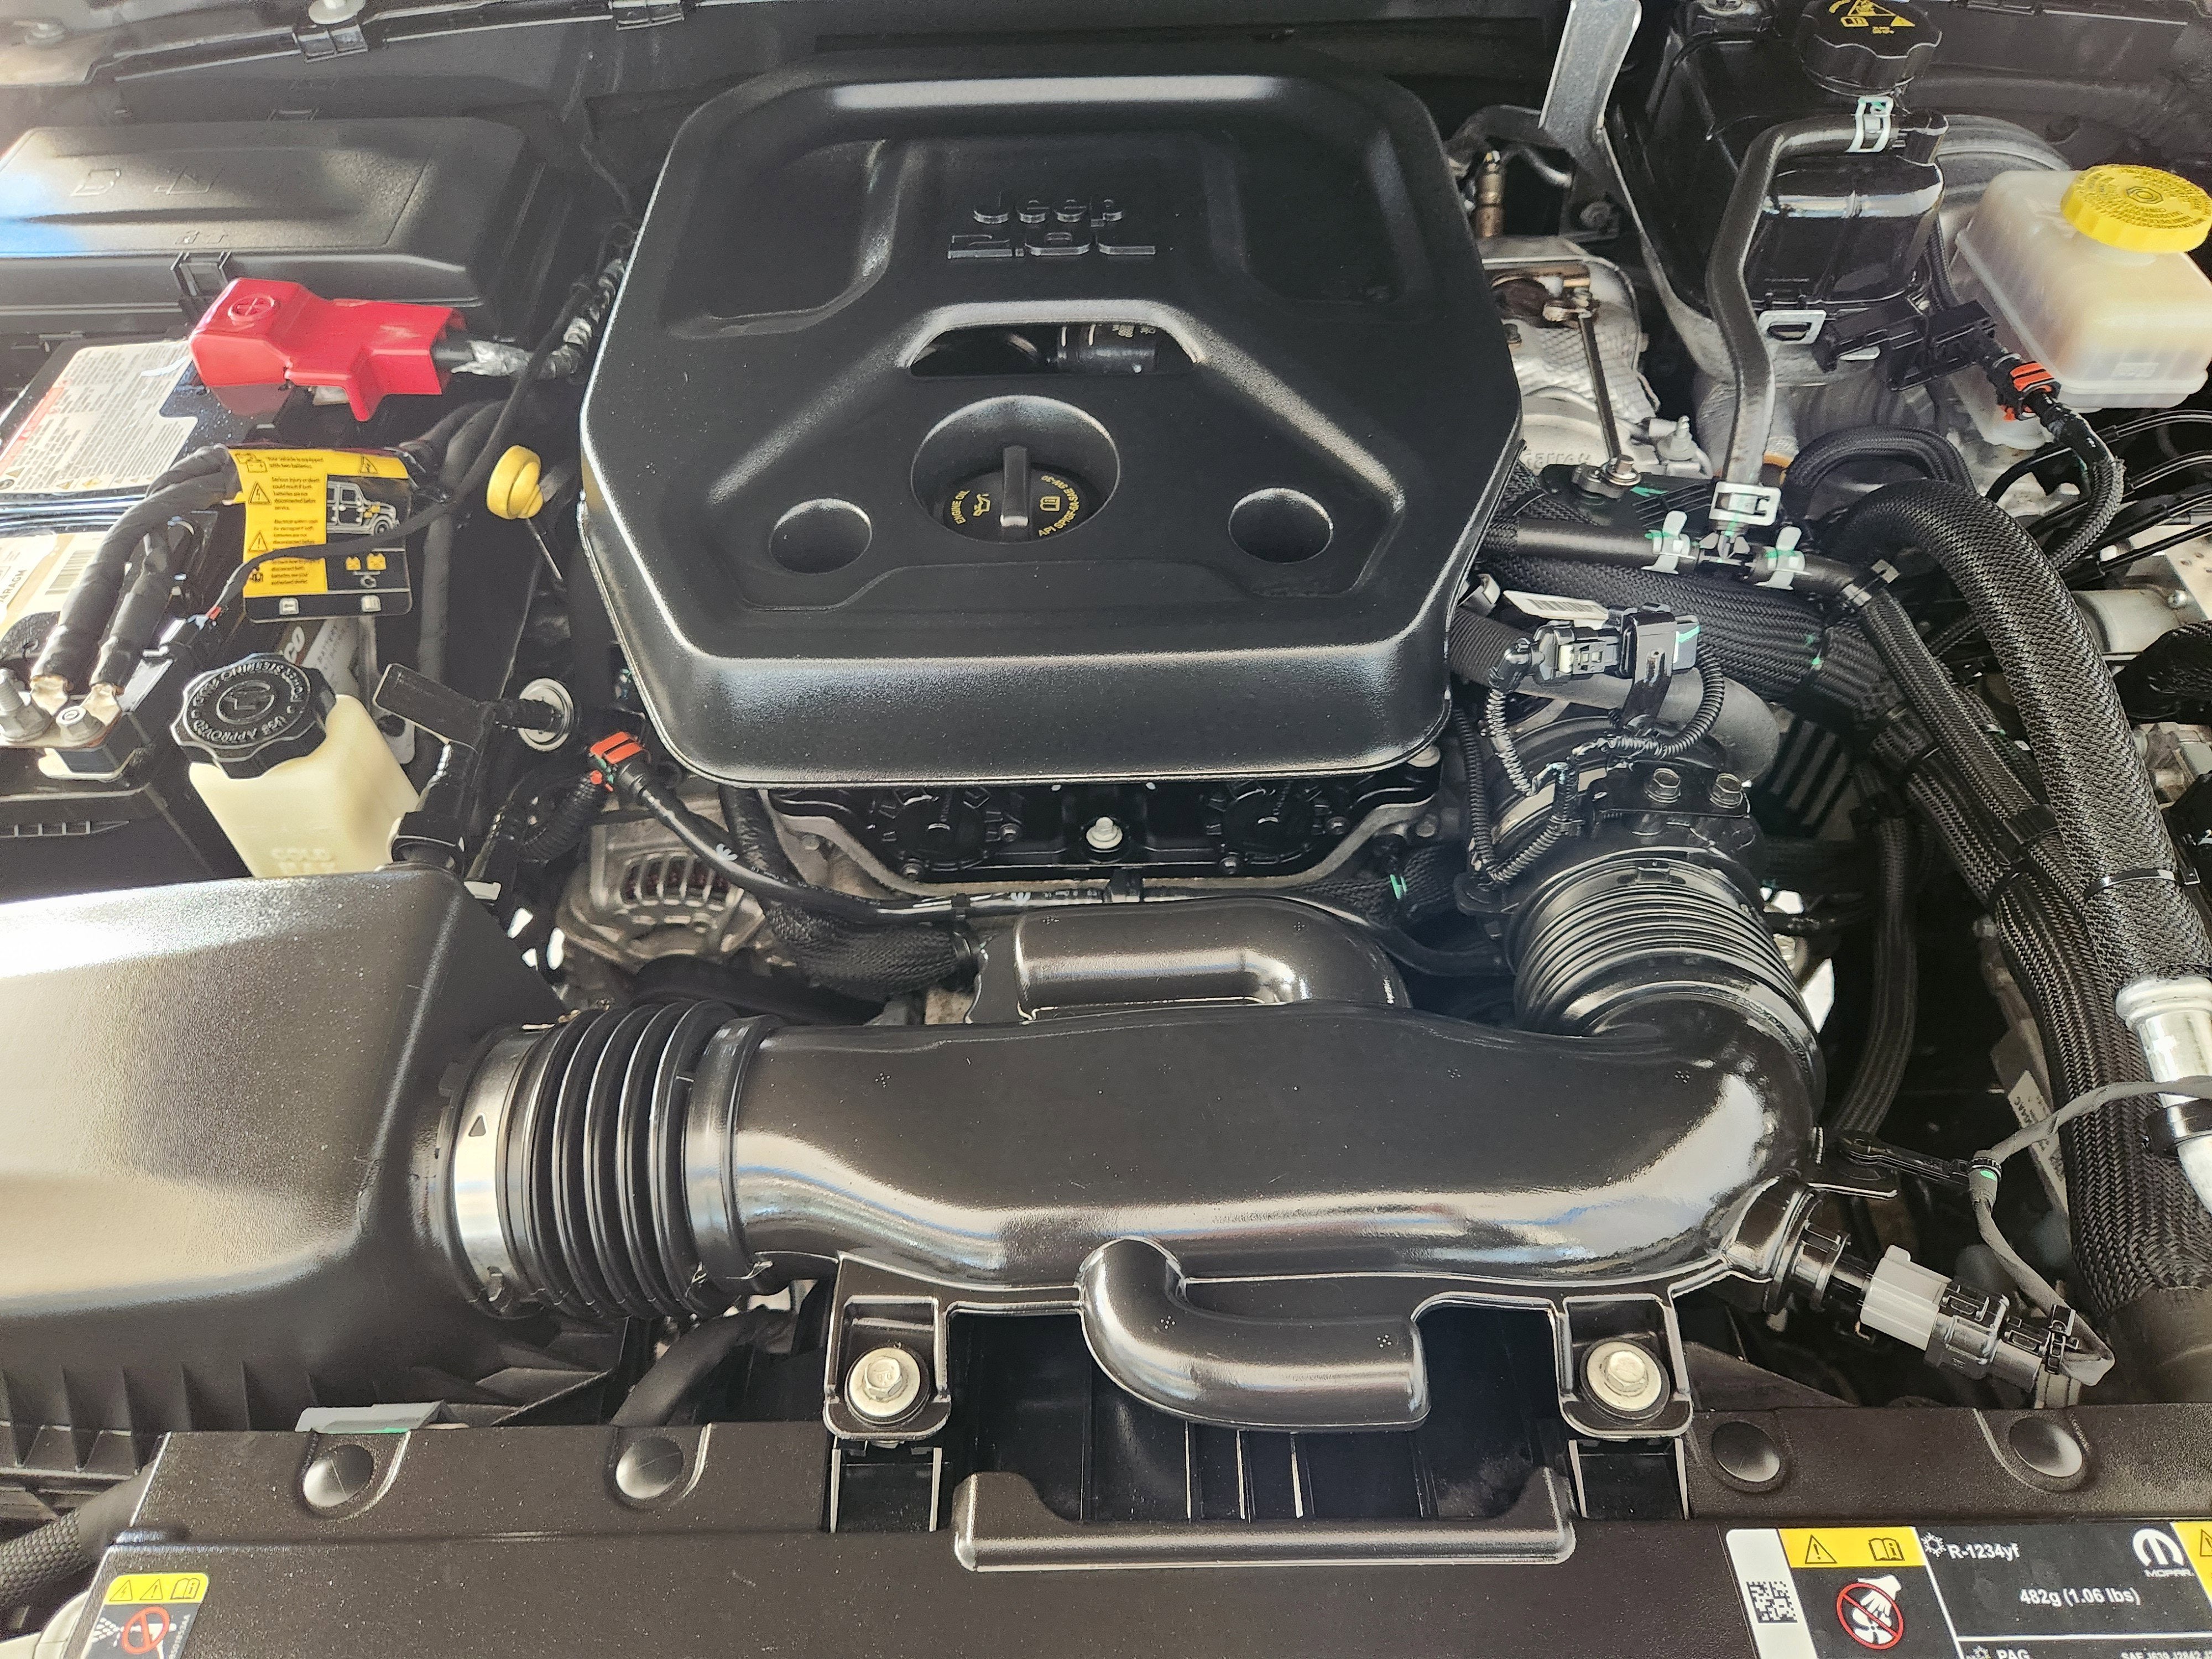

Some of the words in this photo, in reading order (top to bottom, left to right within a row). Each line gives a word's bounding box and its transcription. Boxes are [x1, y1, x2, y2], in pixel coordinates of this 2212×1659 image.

[954, 490, 970, 500] OIL
[951, 500, 966, 524] ENGINE
[1038, 525, 1057, 537] API
[194, 719, 258, 743] APPROVED
[1946, 1542, 2020, 1562] R-1234yf
[2143, 1568, 2192, 1577] MOPAR
[2020, 1588, 2063, 1608] 482g
[2063, 1587, 2105, 1607] (1.06
[2105, 1587, 2141, 1606] lbs)
[1996, 1648, 2031, 1659] PAG
